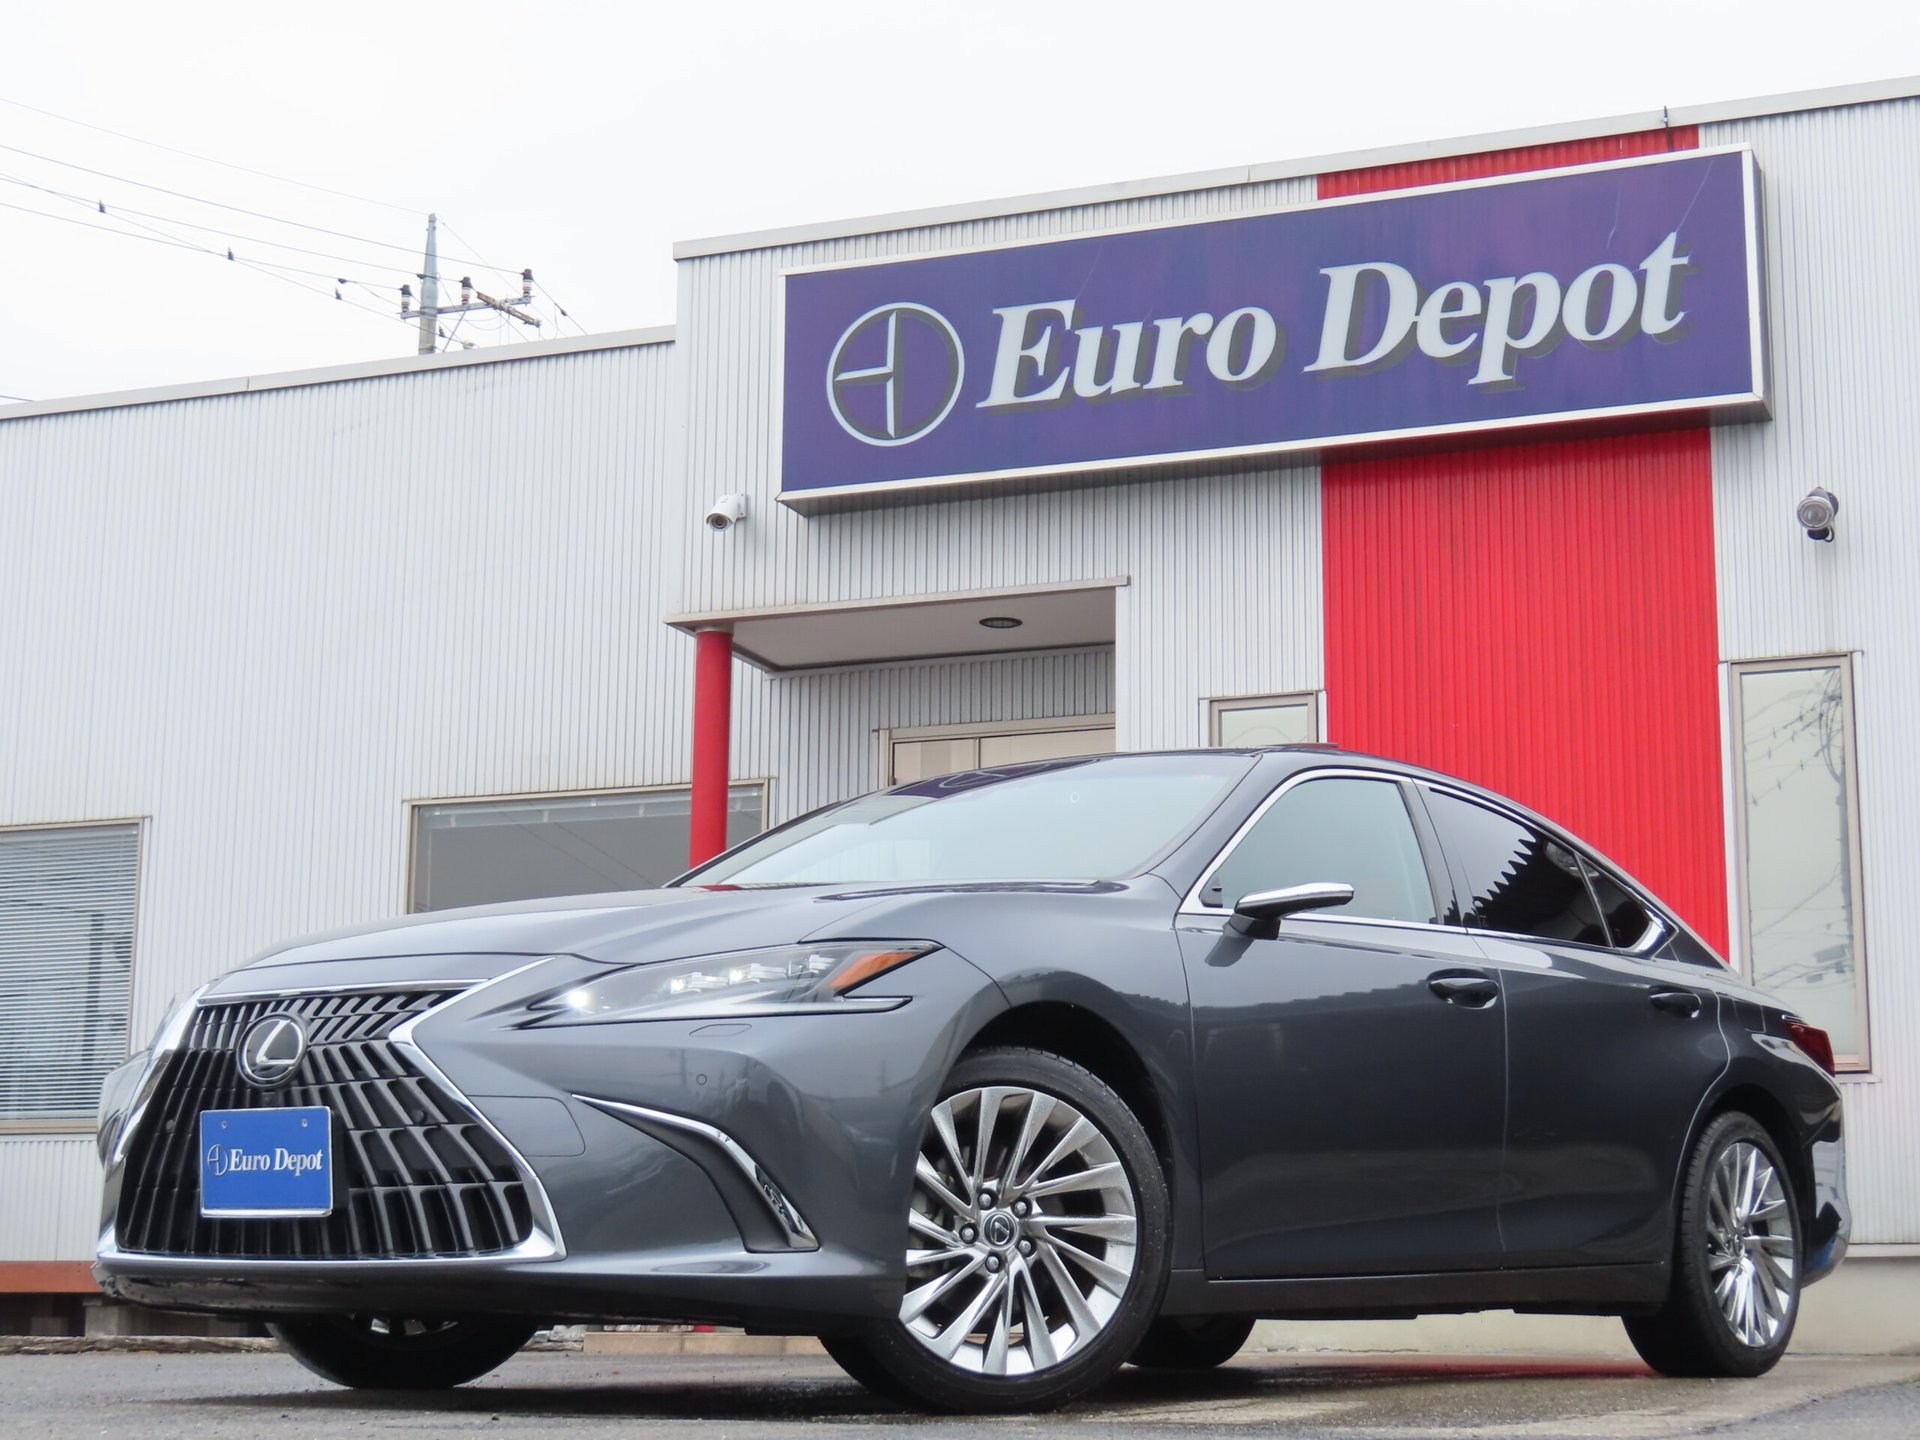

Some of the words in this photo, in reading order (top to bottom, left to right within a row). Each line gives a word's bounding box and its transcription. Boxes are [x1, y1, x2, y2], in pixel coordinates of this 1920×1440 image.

[975, 299, 1277, 408] Euro
[1304, 231, 1690, 386] Depot
[228, 1148, 271, 1171] Euro
[273, 1147, 323, 1176] Depot
